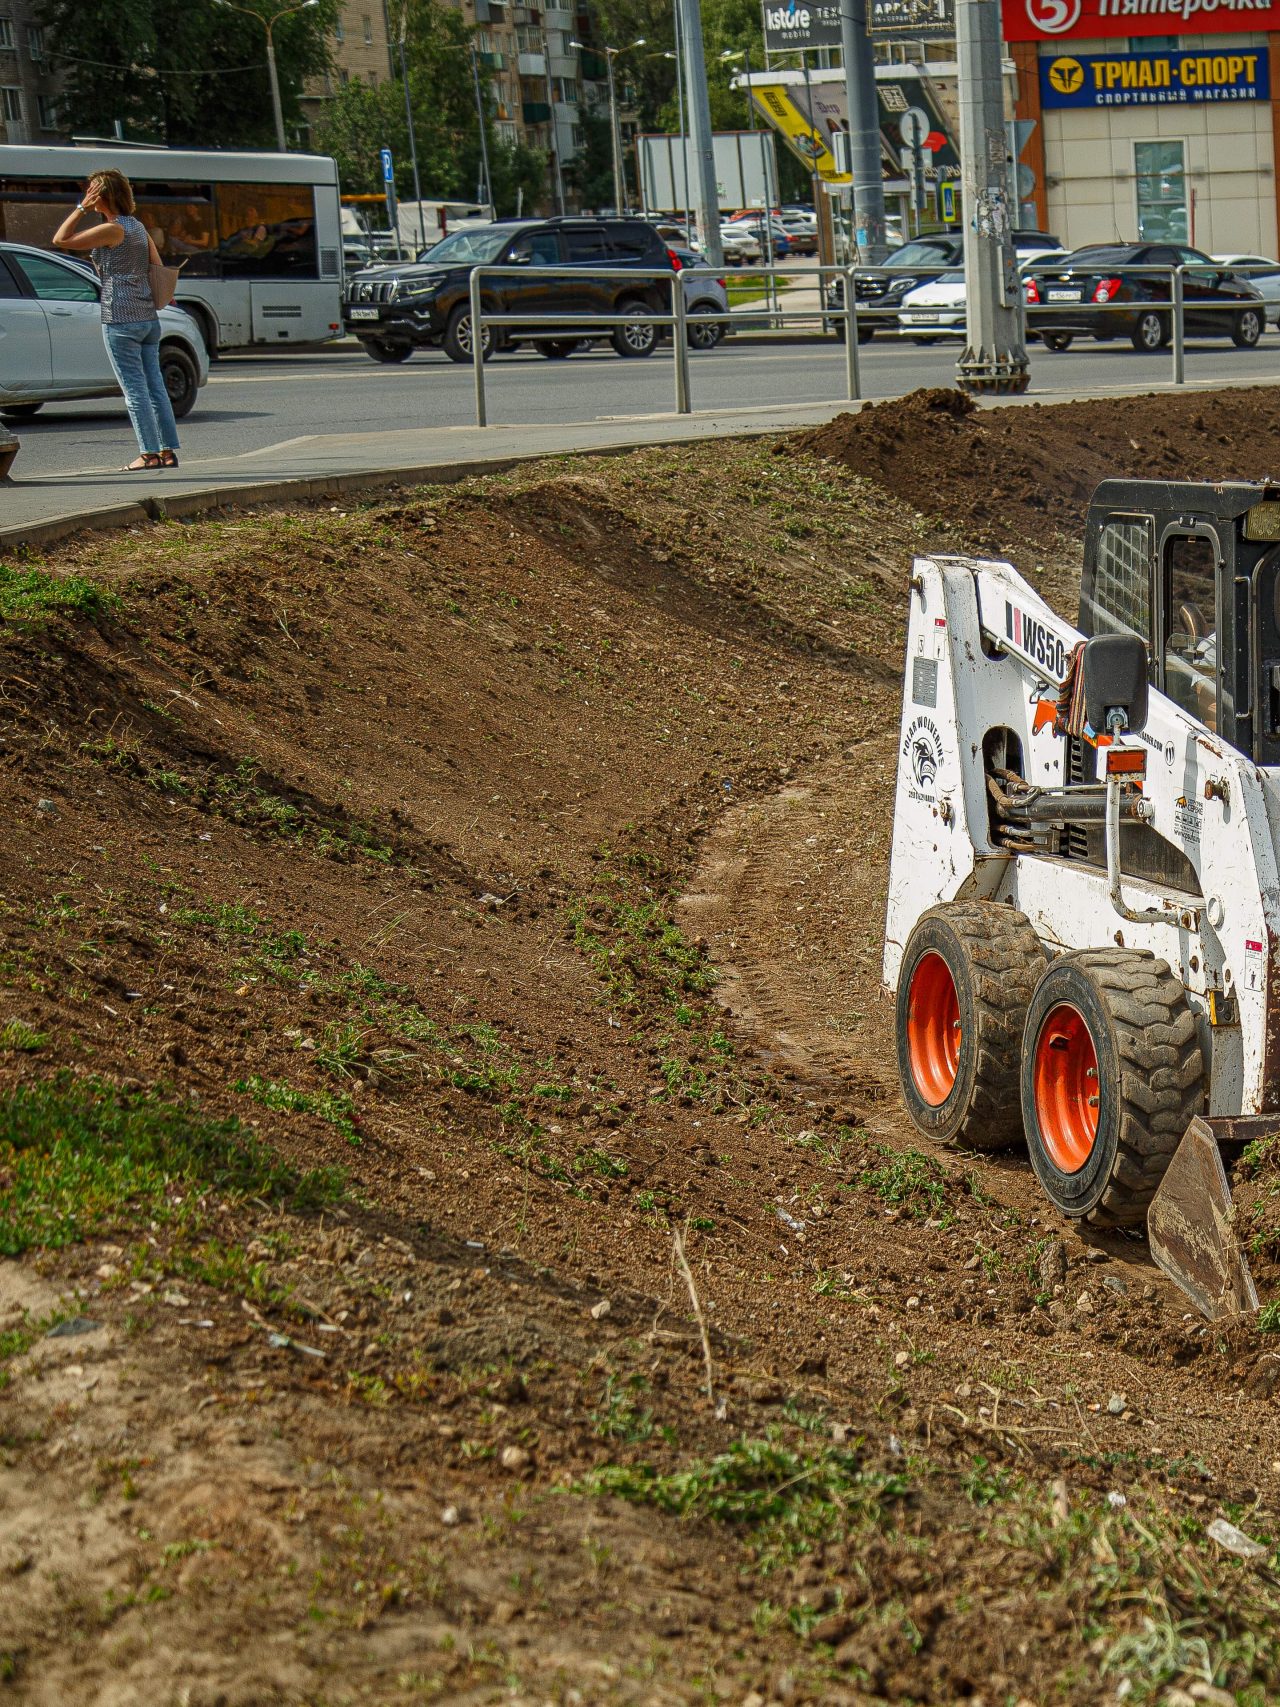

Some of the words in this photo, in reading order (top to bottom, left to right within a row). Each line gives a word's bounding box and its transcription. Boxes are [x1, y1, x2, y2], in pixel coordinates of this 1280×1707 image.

[765, 8, 810, 30] kstore
[1095, 89, 1187, 104] СПОРТИВНЫЙ
[1193, 87, 1257, 101] МАГАЗИН
[1022, 612, 1066, 679] WS50
[902, 720, 918, 757] POLAR
[917, 716, 945, 768] WOLVERINE
